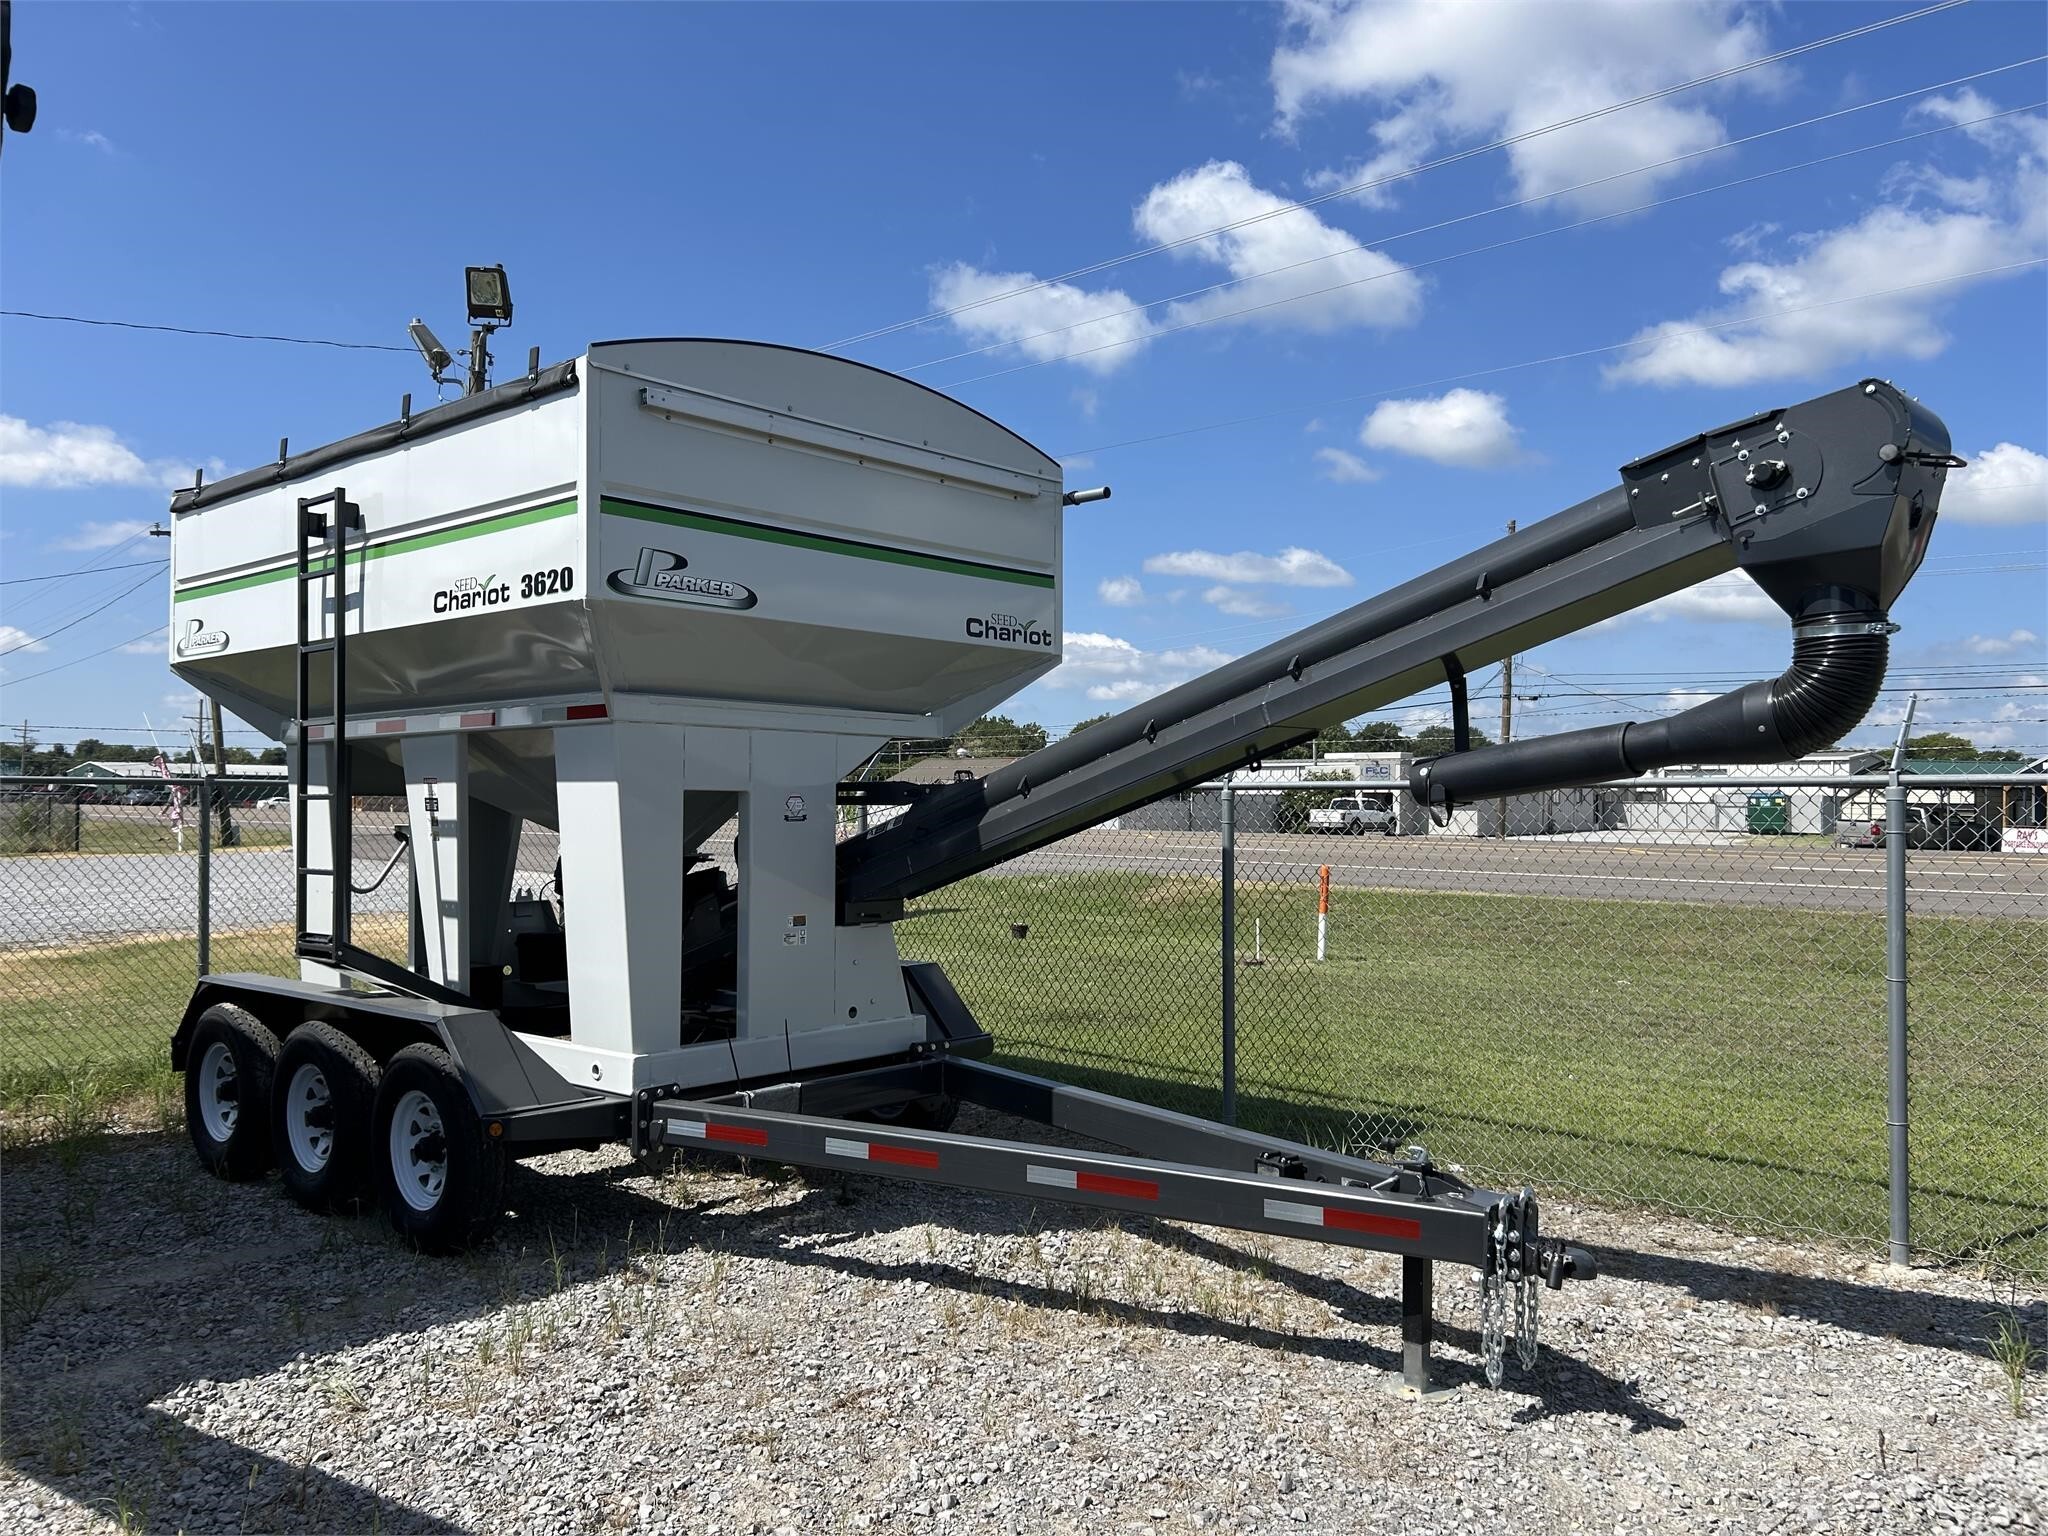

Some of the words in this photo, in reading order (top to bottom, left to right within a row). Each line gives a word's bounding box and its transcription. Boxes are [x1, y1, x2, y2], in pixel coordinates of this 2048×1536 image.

[433, 583, 510, 613] Chariot
[521, 566, 574, 599] 3620
[454, 576, 478, 592] SEED
[655, 572, 735, 597] PARKER
[965, 617, 1052, 646] Chariot
[990, 613, 1018, 628] SEED
